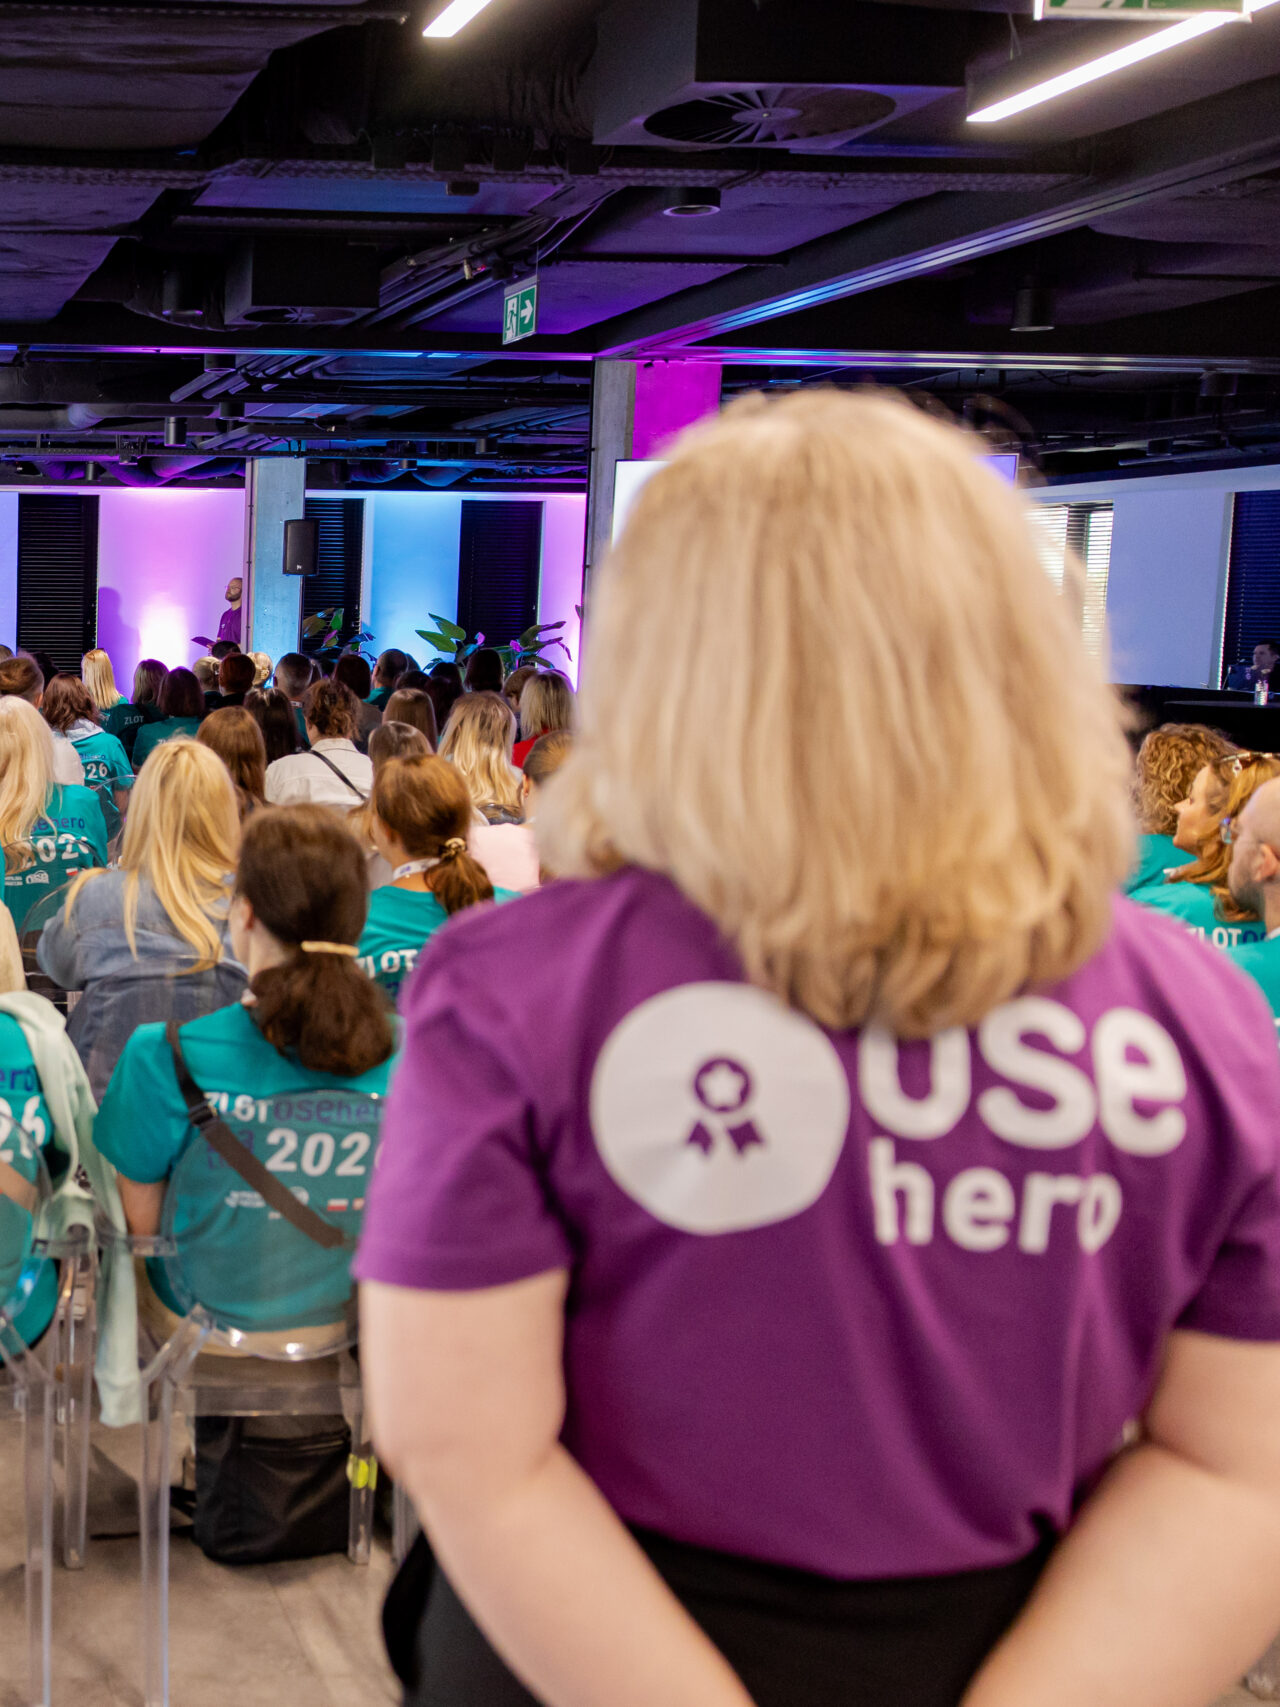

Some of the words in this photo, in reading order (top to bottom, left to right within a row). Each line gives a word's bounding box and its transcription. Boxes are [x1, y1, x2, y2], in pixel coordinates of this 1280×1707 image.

[86, 762, 108, 779] 26
[857, 995, 1189, 1158] ose
[264, 1127, 385, 1177] 202
[867, 1136, 1123, 1256] hero
